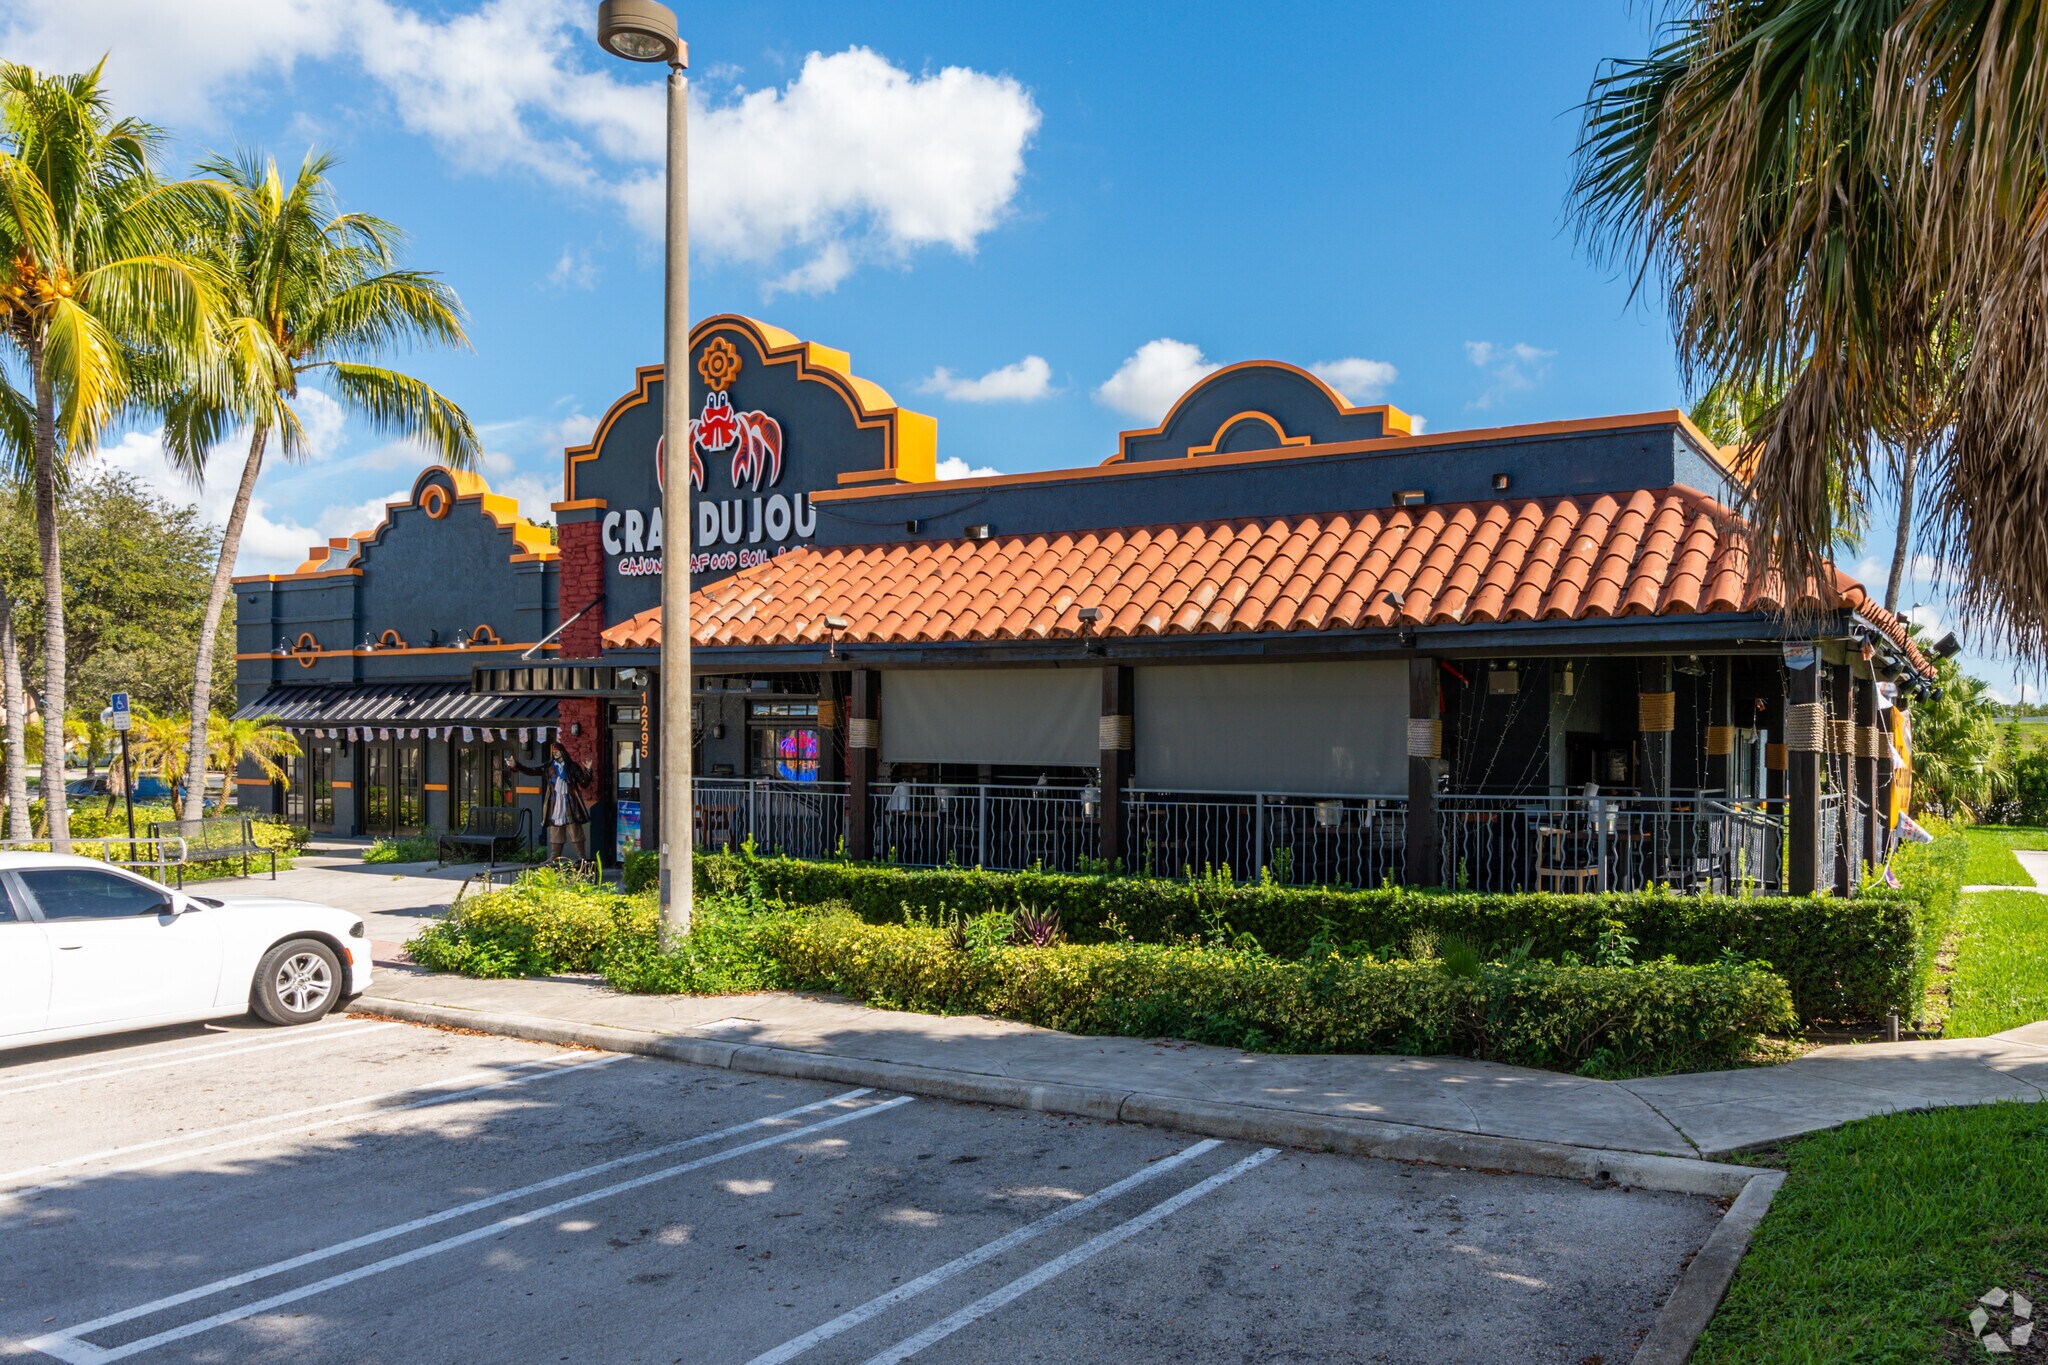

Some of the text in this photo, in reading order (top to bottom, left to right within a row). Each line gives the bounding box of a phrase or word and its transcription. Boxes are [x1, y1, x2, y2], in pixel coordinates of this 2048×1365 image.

[602, 507, 664, 556] CRA
[699, 499, 743, 547] DU
[690, 551, 736, 573] AFOOD
[739, 548, 769, 567] BOIL
[640, 691, 649, 758] 12295
